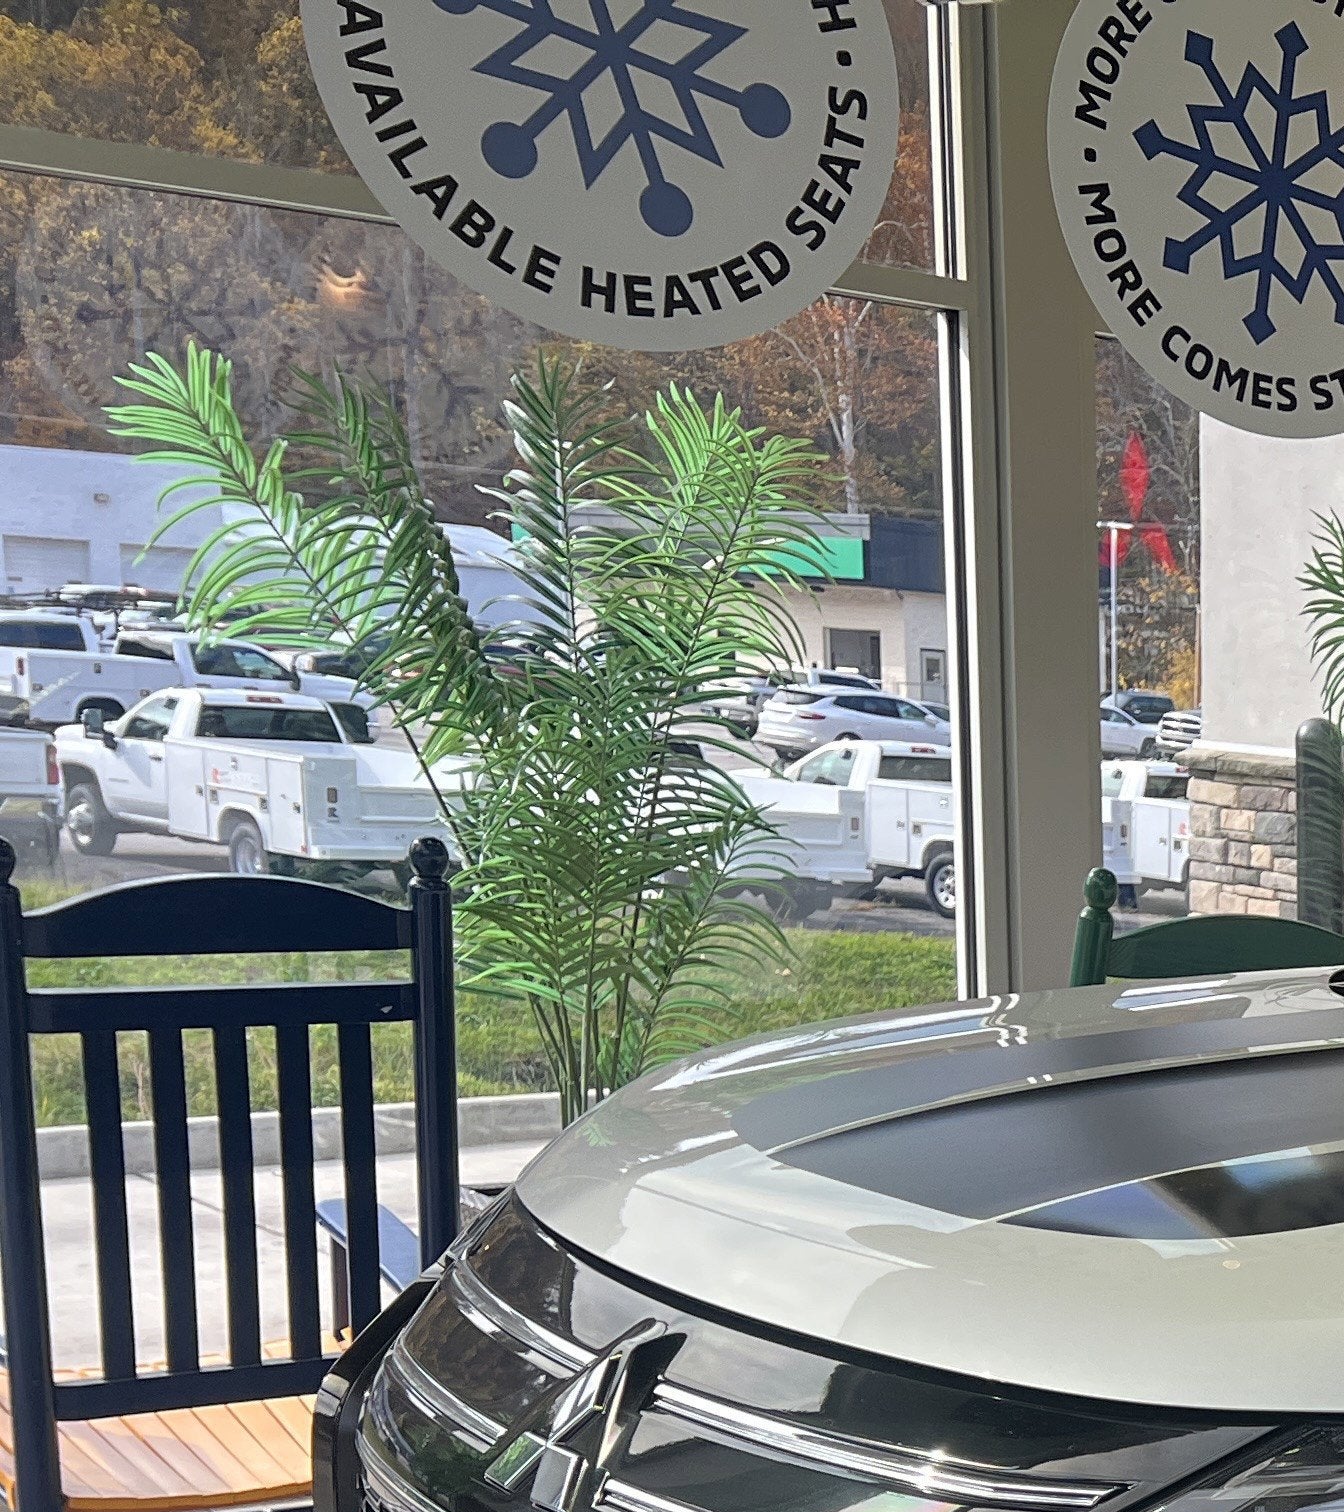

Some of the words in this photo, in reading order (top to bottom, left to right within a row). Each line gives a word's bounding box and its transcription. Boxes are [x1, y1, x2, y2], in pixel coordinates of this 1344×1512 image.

[337, 0, 562, 294] AVAILABLE
[581, 240, 791, 318] HEATED
[785, 85, 868, 251] SEATS
[1075, 0, 1153, 131] MORE
[1078, 183, 1163, 327] MORE
[1161, 325, 1298, 413] COMES
